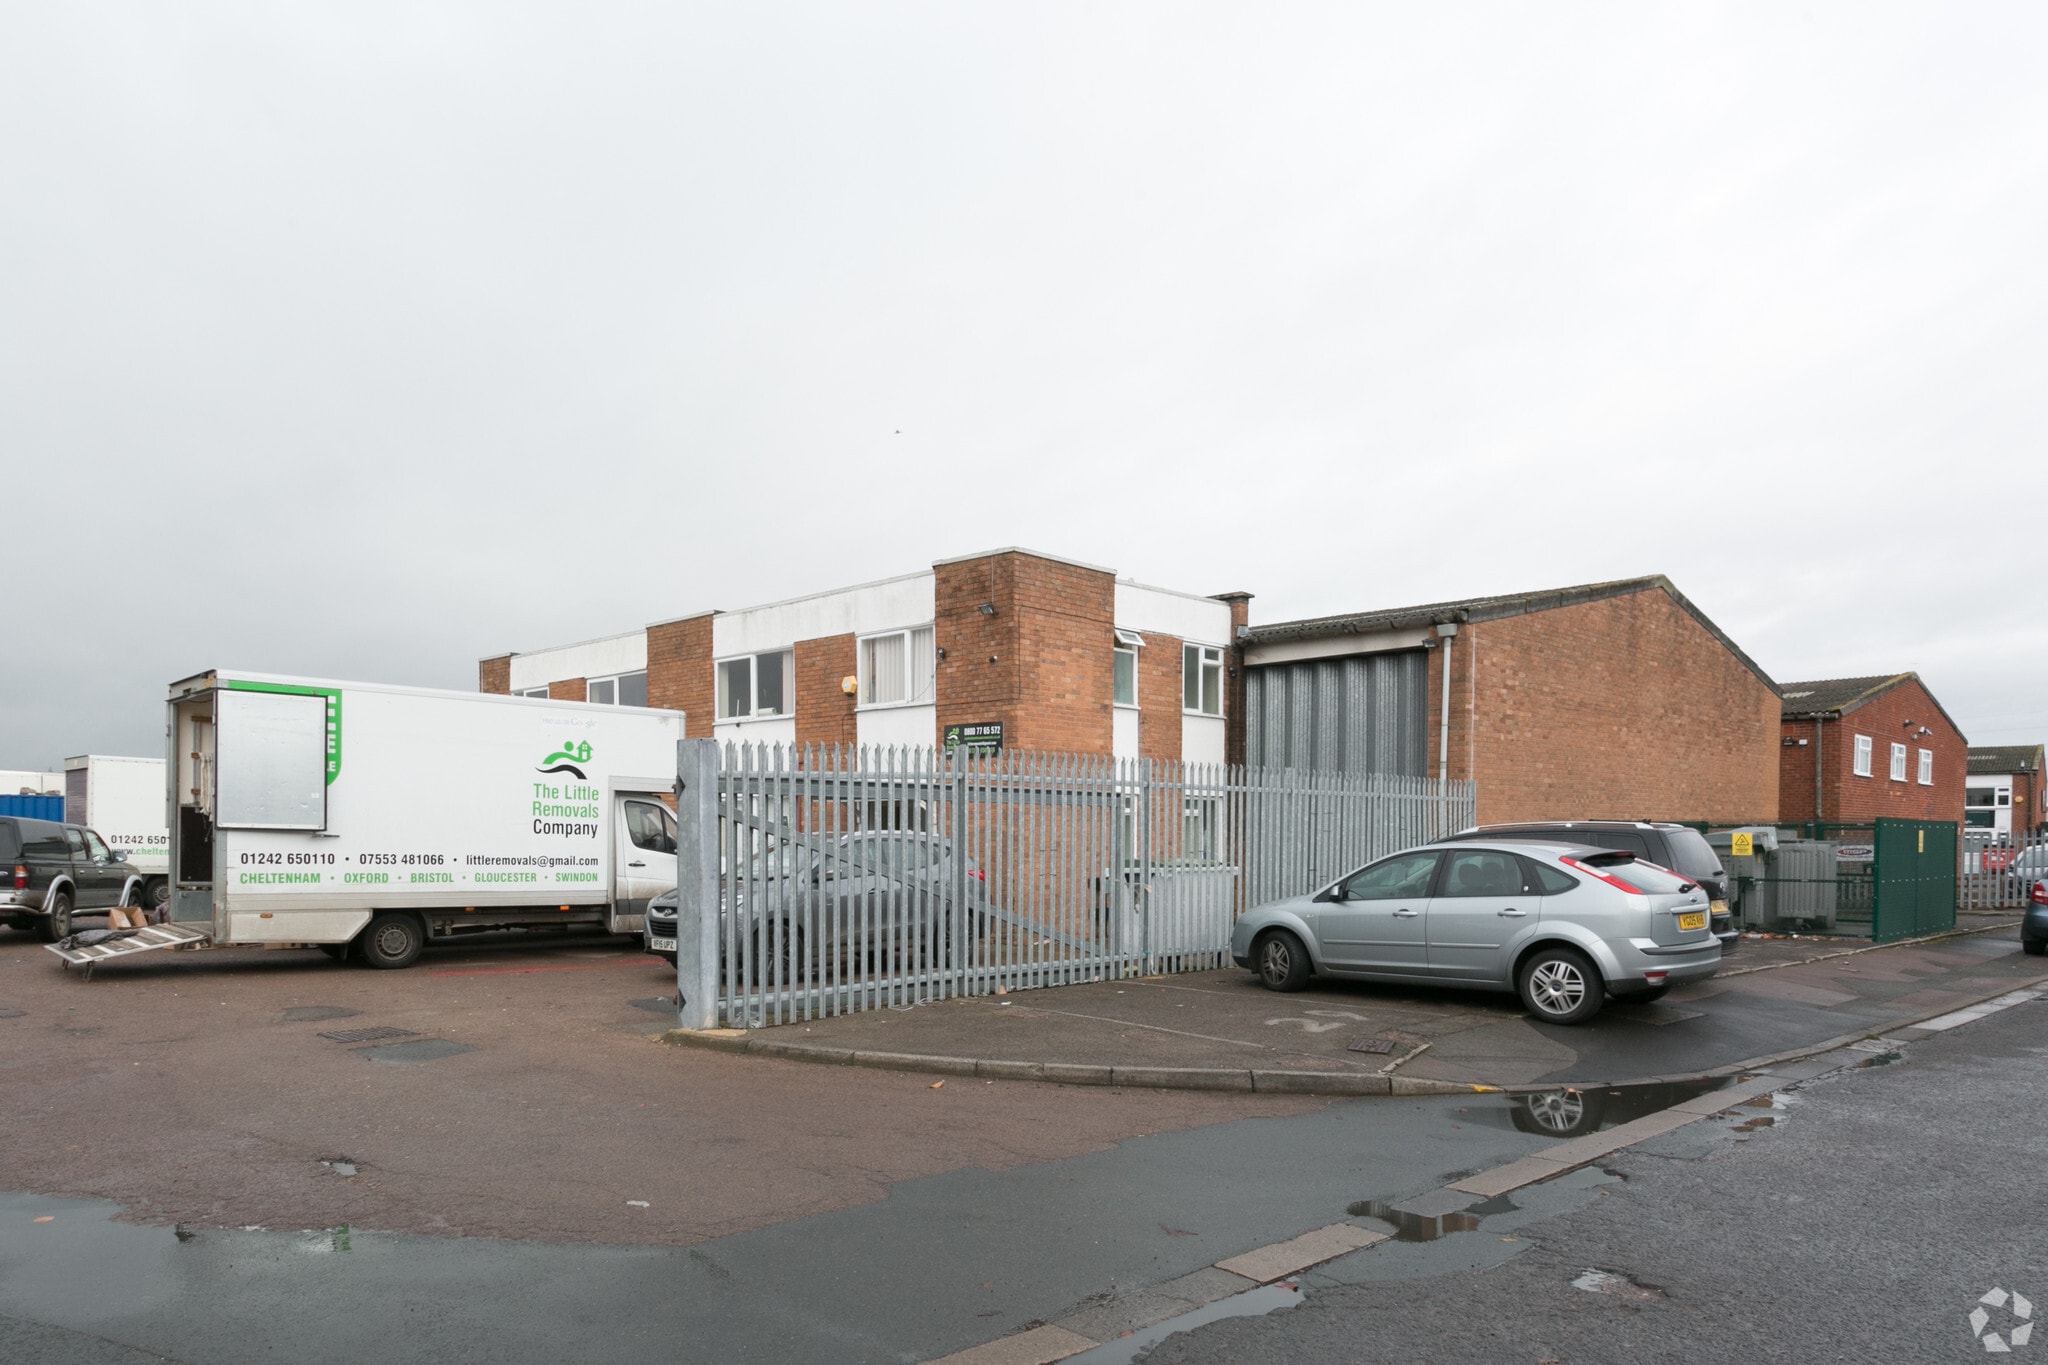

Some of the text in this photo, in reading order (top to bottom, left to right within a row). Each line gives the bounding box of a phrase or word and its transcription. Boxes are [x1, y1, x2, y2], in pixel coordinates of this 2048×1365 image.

[976, 727, 982, 735] 77
[991, 726, 1001, 734] 572
[533, 783, 599, 801] The Little
[532, 801, 599, 818] Removals
[533, 819, 598, 839] Company
[111, 834, 144, 844] 01242
[240, 852, 599, 868] 01242 650110 07553 481066 littleremovals@gmail.com
[239, 872, 598, 884] CHELTENHAM OXFORD BRISTOL GLOUCESTER SWINDON
